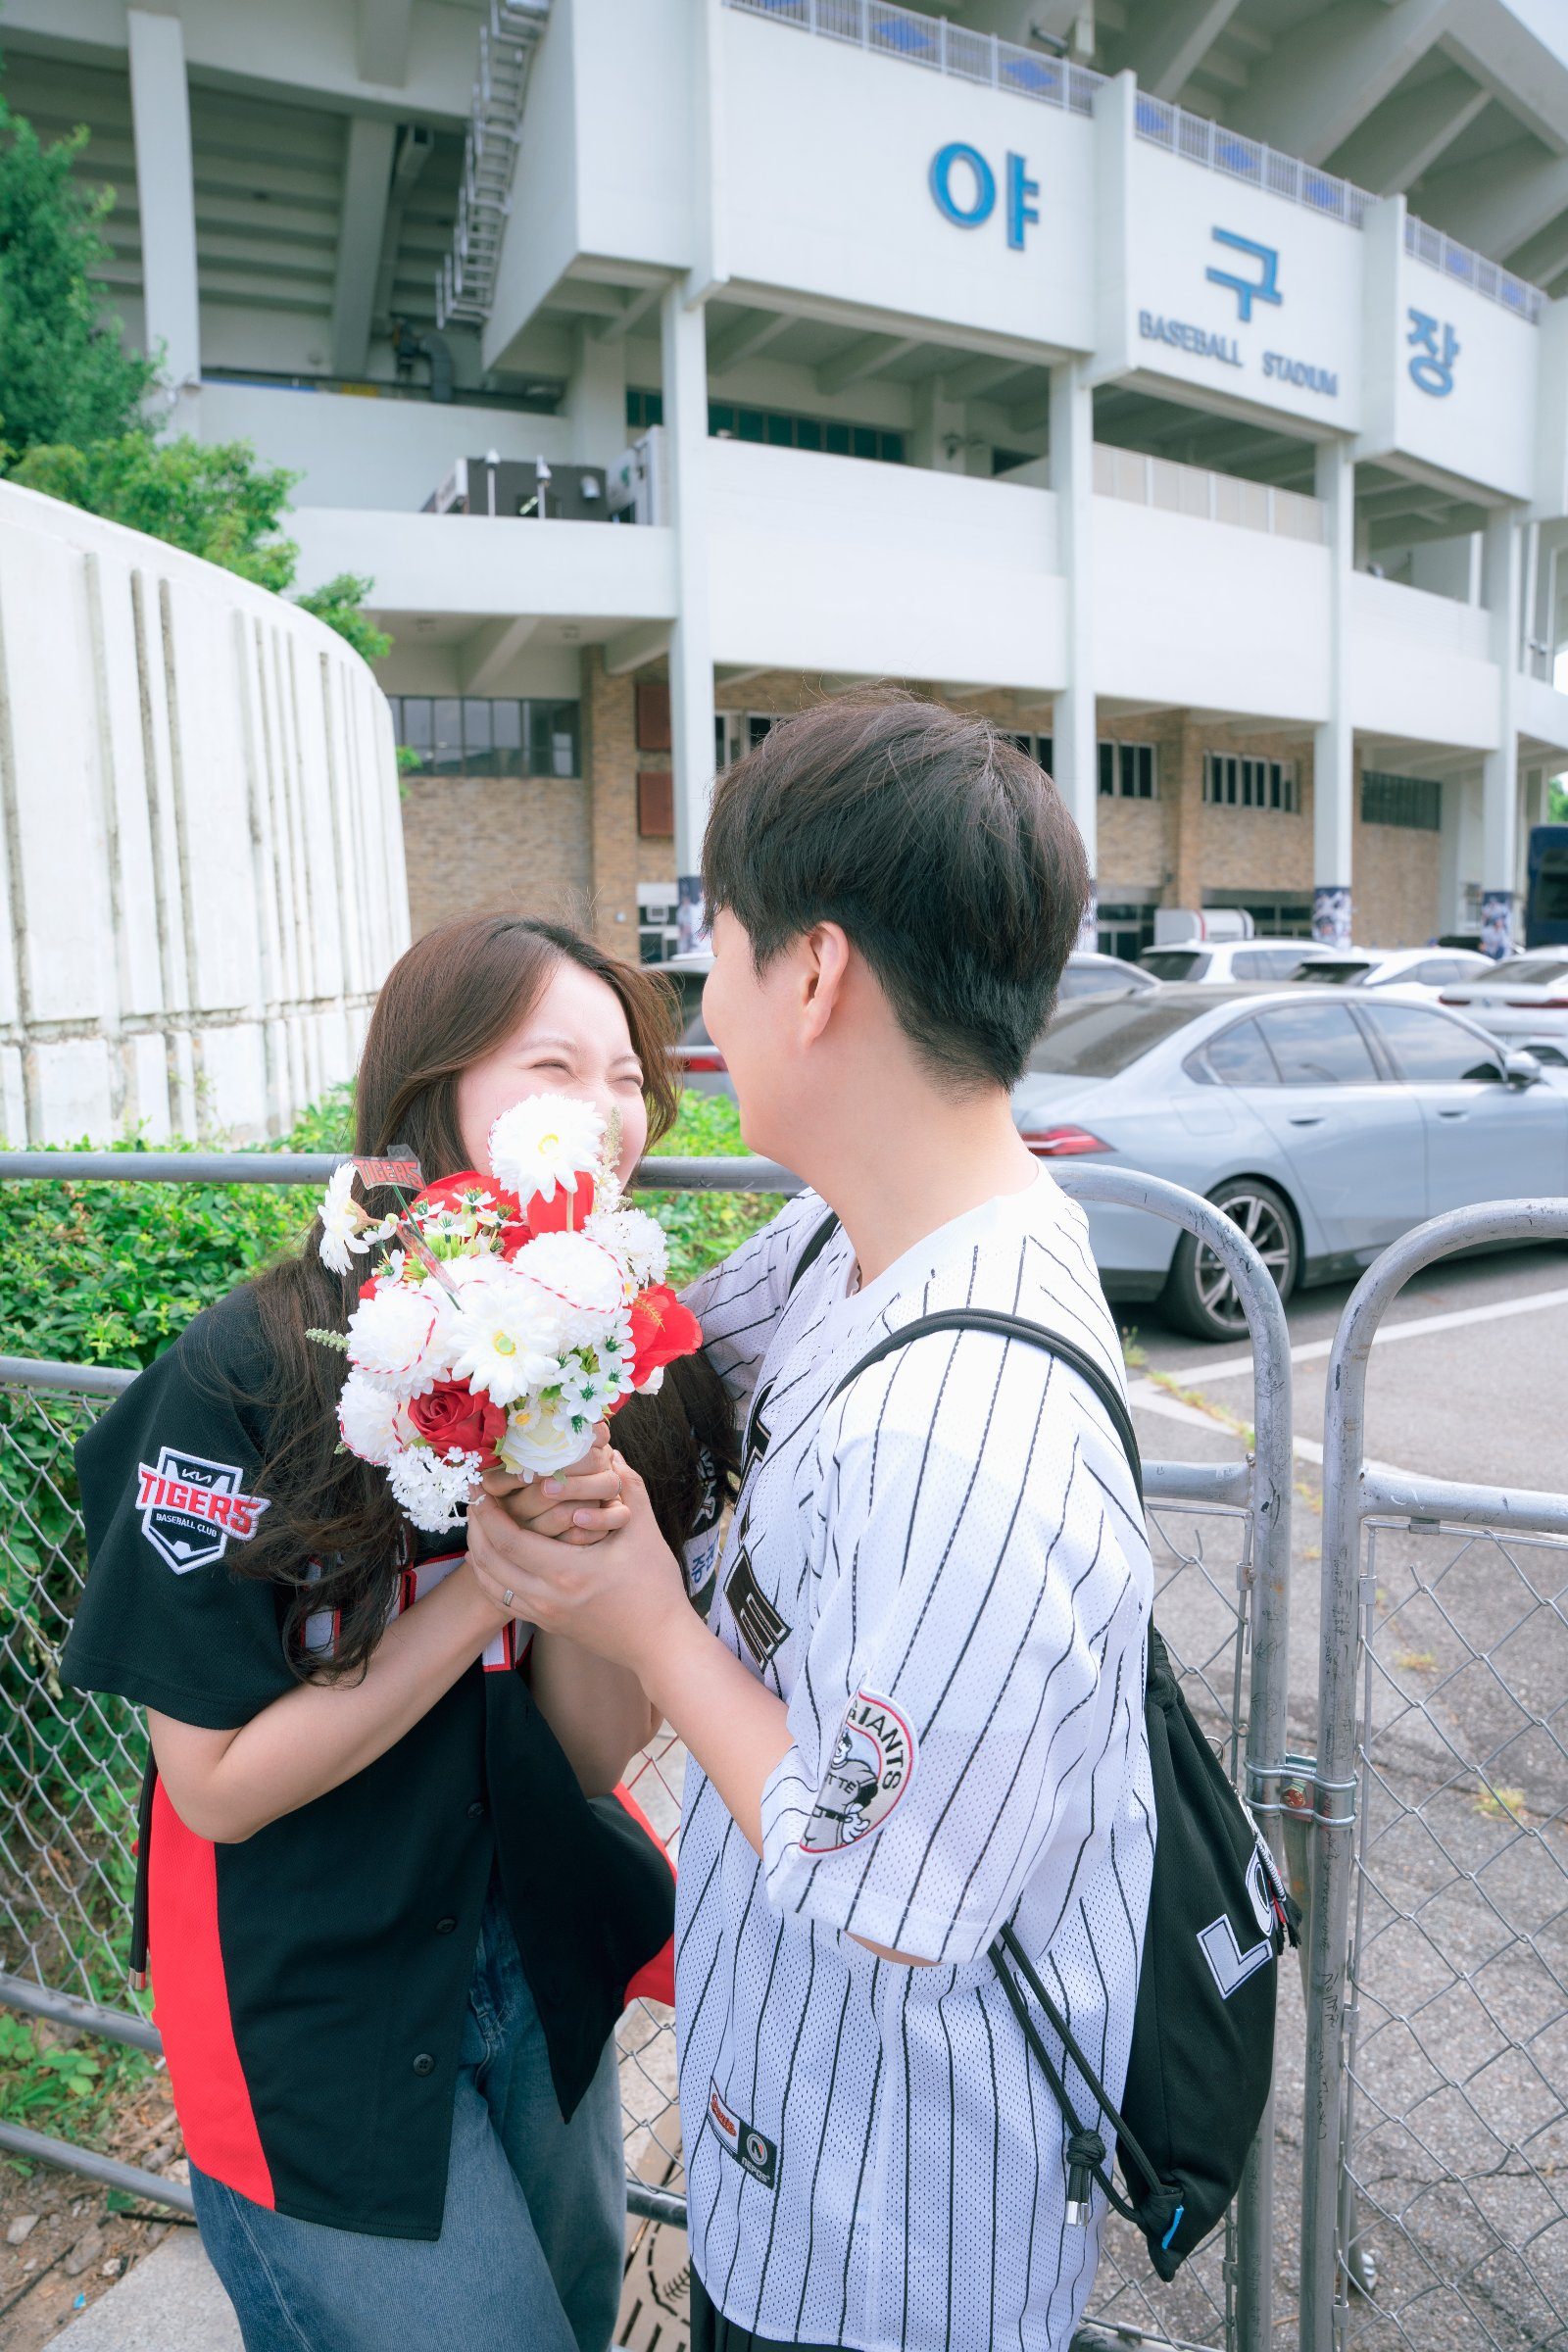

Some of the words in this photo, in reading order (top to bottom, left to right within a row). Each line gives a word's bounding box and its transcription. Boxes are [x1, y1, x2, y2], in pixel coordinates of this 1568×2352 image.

[1139, 310, 1243, 368] BASEBALL
[1262, 350, 1339, 397] STADIUM
[351, 1159, 425, 1192] TIGERS
[141, 1470, 261, 1535] TIGERS
[156, 1512, 196, 1530] BASEBALL
[197, 1523, 217, 1538] CLUB
